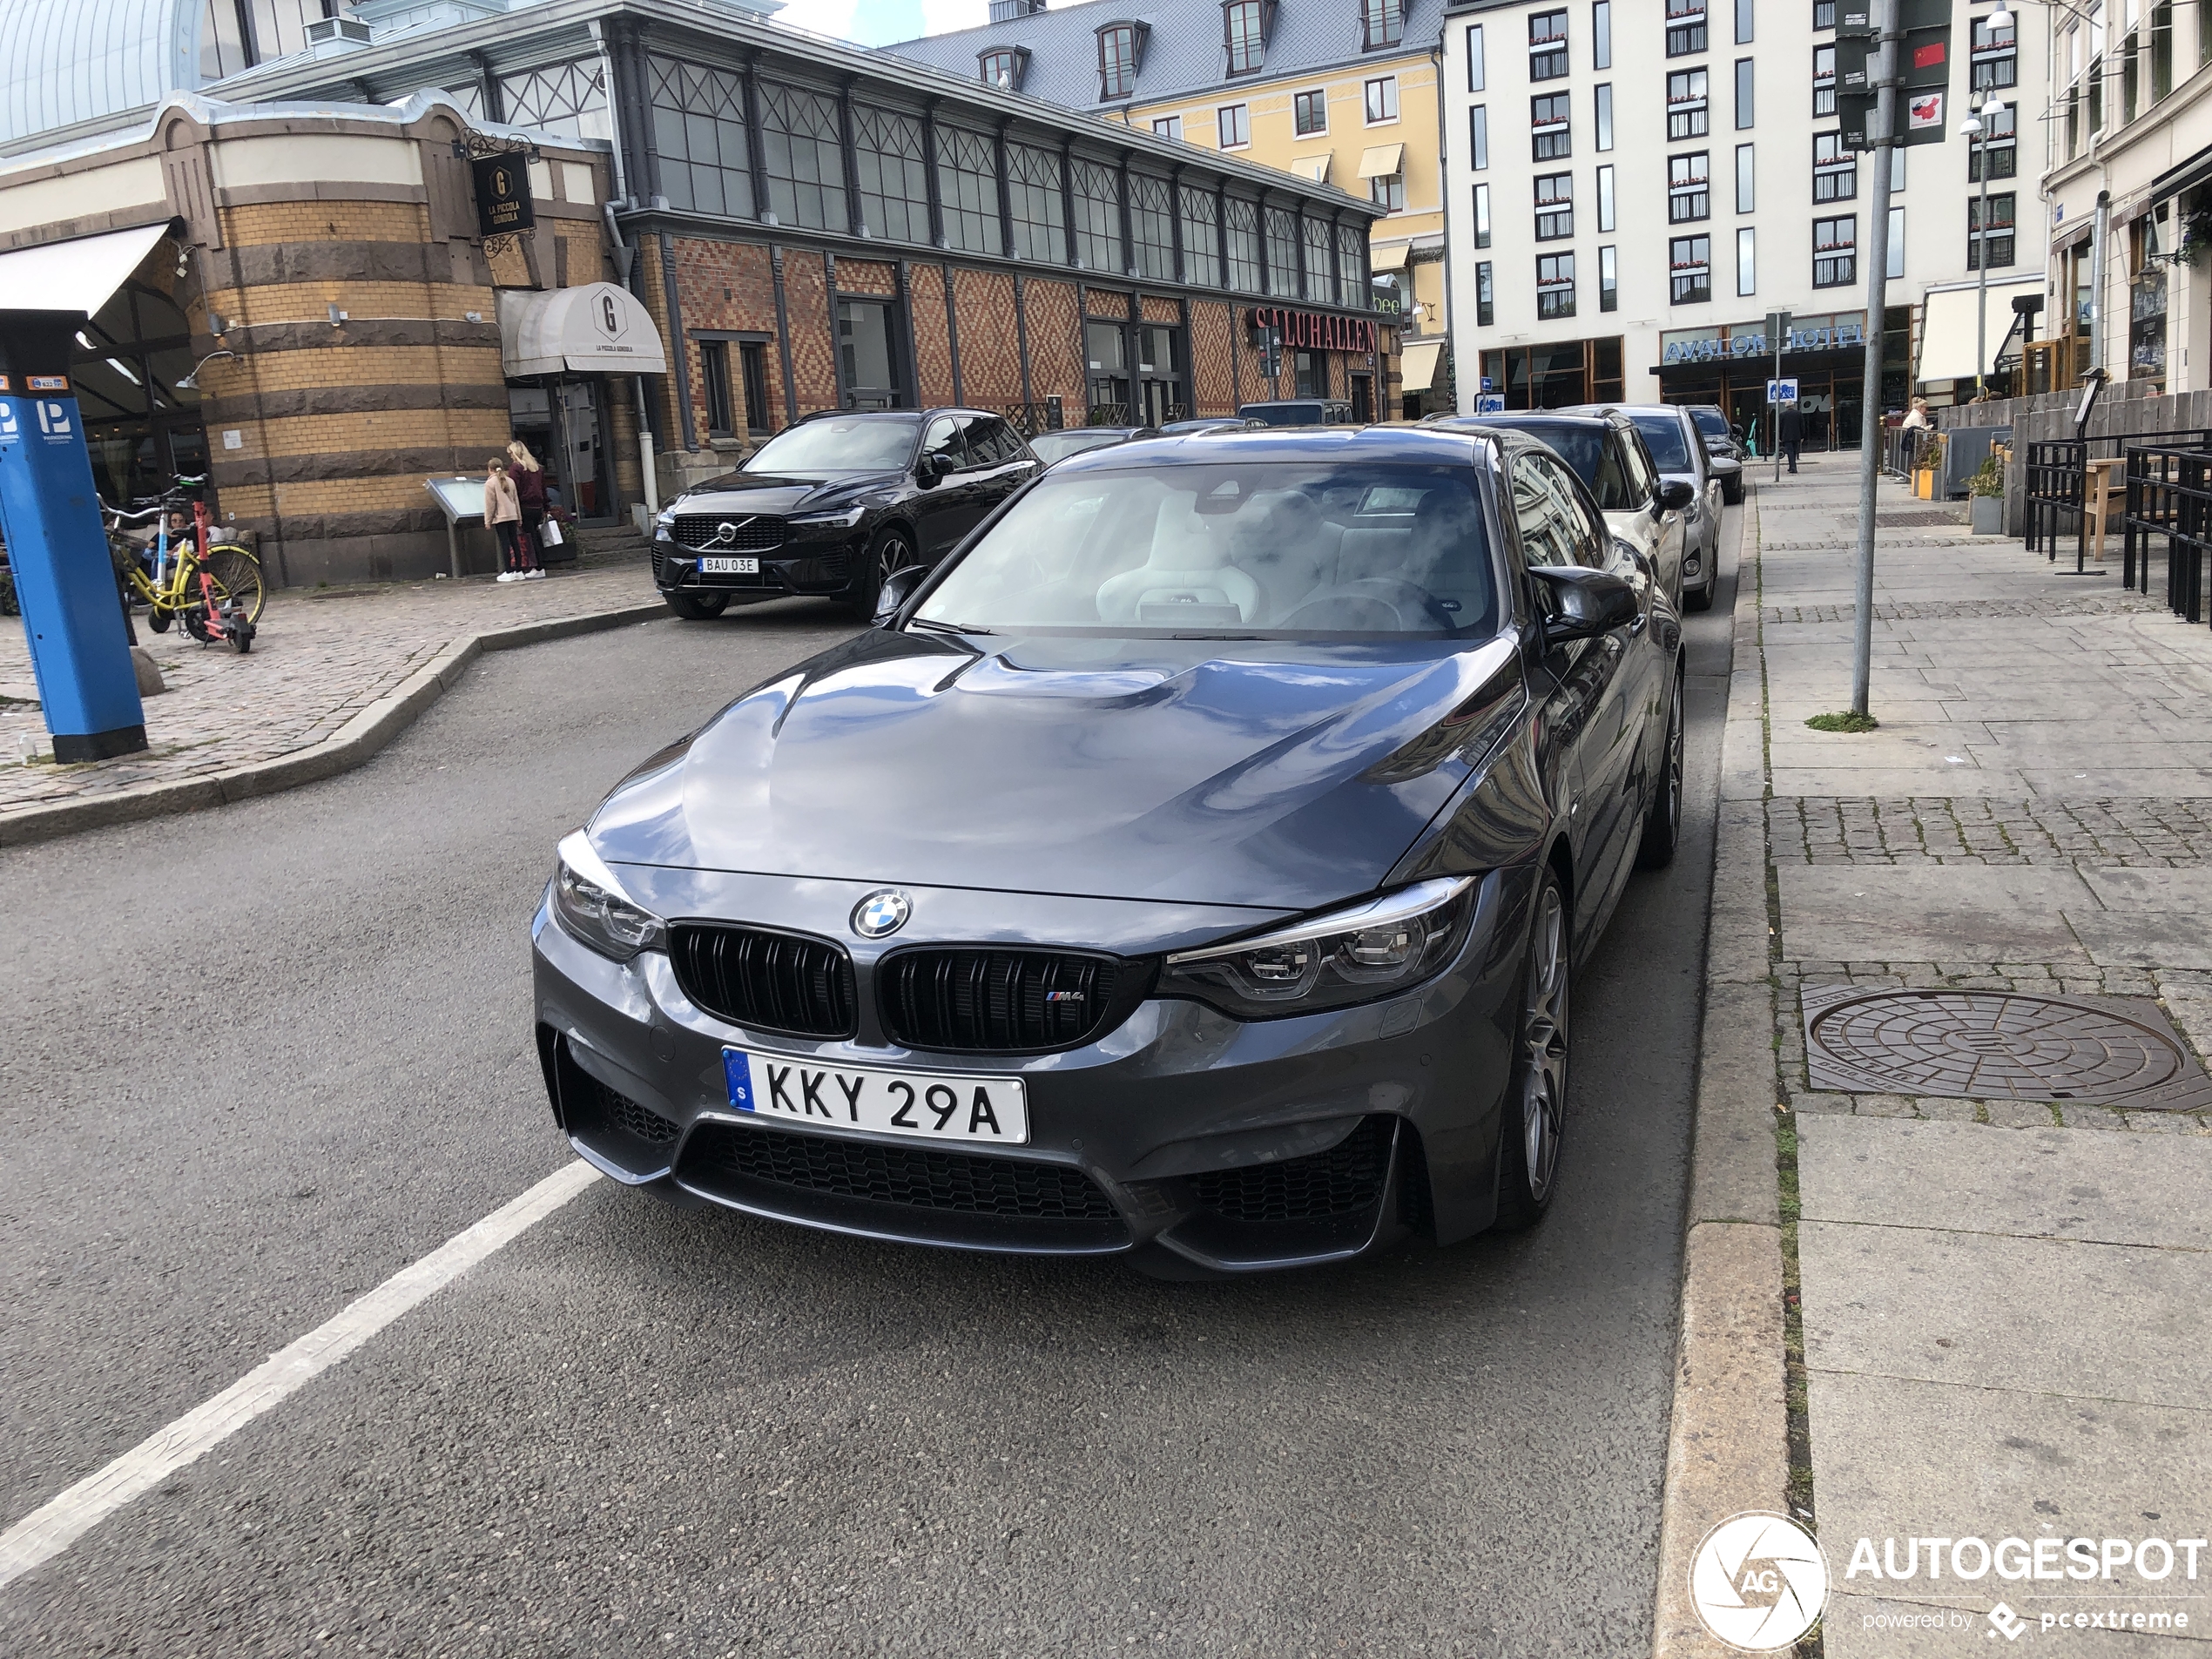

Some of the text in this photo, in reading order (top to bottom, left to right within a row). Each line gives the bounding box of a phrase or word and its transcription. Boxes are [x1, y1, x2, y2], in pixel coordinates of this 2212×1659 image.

[496, 171, 506, 195] G
[488, 206, 496, 215] LA
[603, 295, 617, 332] G
[1255, 306, 1375, 353] SALUHALLEN
[1663, 334, 1766, 361] AVALON
[706, 559, 728, 570] BAU
[732, 559, 753, 571] 03E
[1052, 991, 1084, 1001] M4
[1817, 1061, 1859, 1077] D400
[737, 1085, 746, 1101] S
[765, 1062, 1001, 1135] KKY 29A
